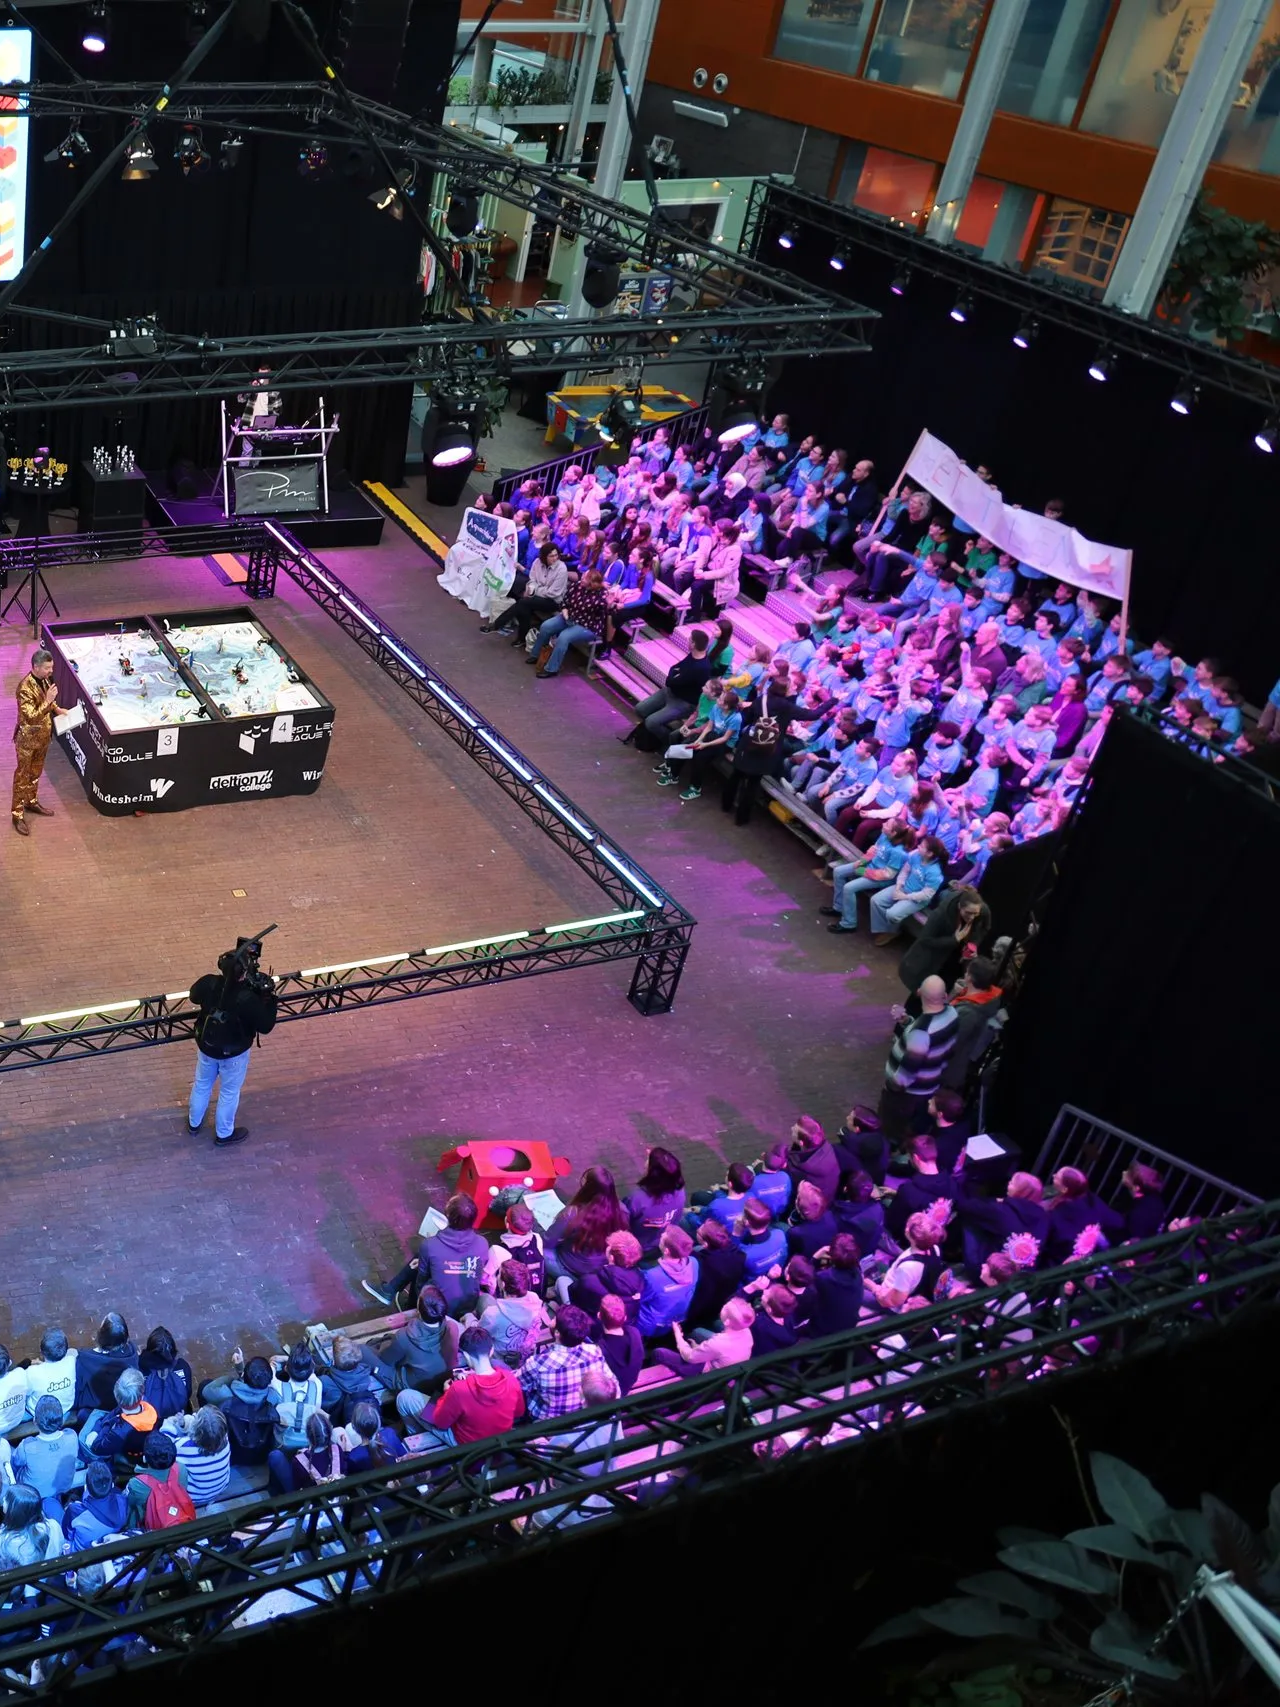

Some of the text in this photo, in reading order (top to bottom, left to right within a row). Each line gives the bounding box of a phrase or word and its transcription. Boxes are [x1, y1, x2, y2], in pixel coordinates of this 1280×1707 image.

[279, 722, 287, 733] 4
[164, 735, 173, 746] 3
[212, 774, 259, 788] deltion
[92, 781, 154, 804] Windesheim
[240, 782, 272, 792] college
